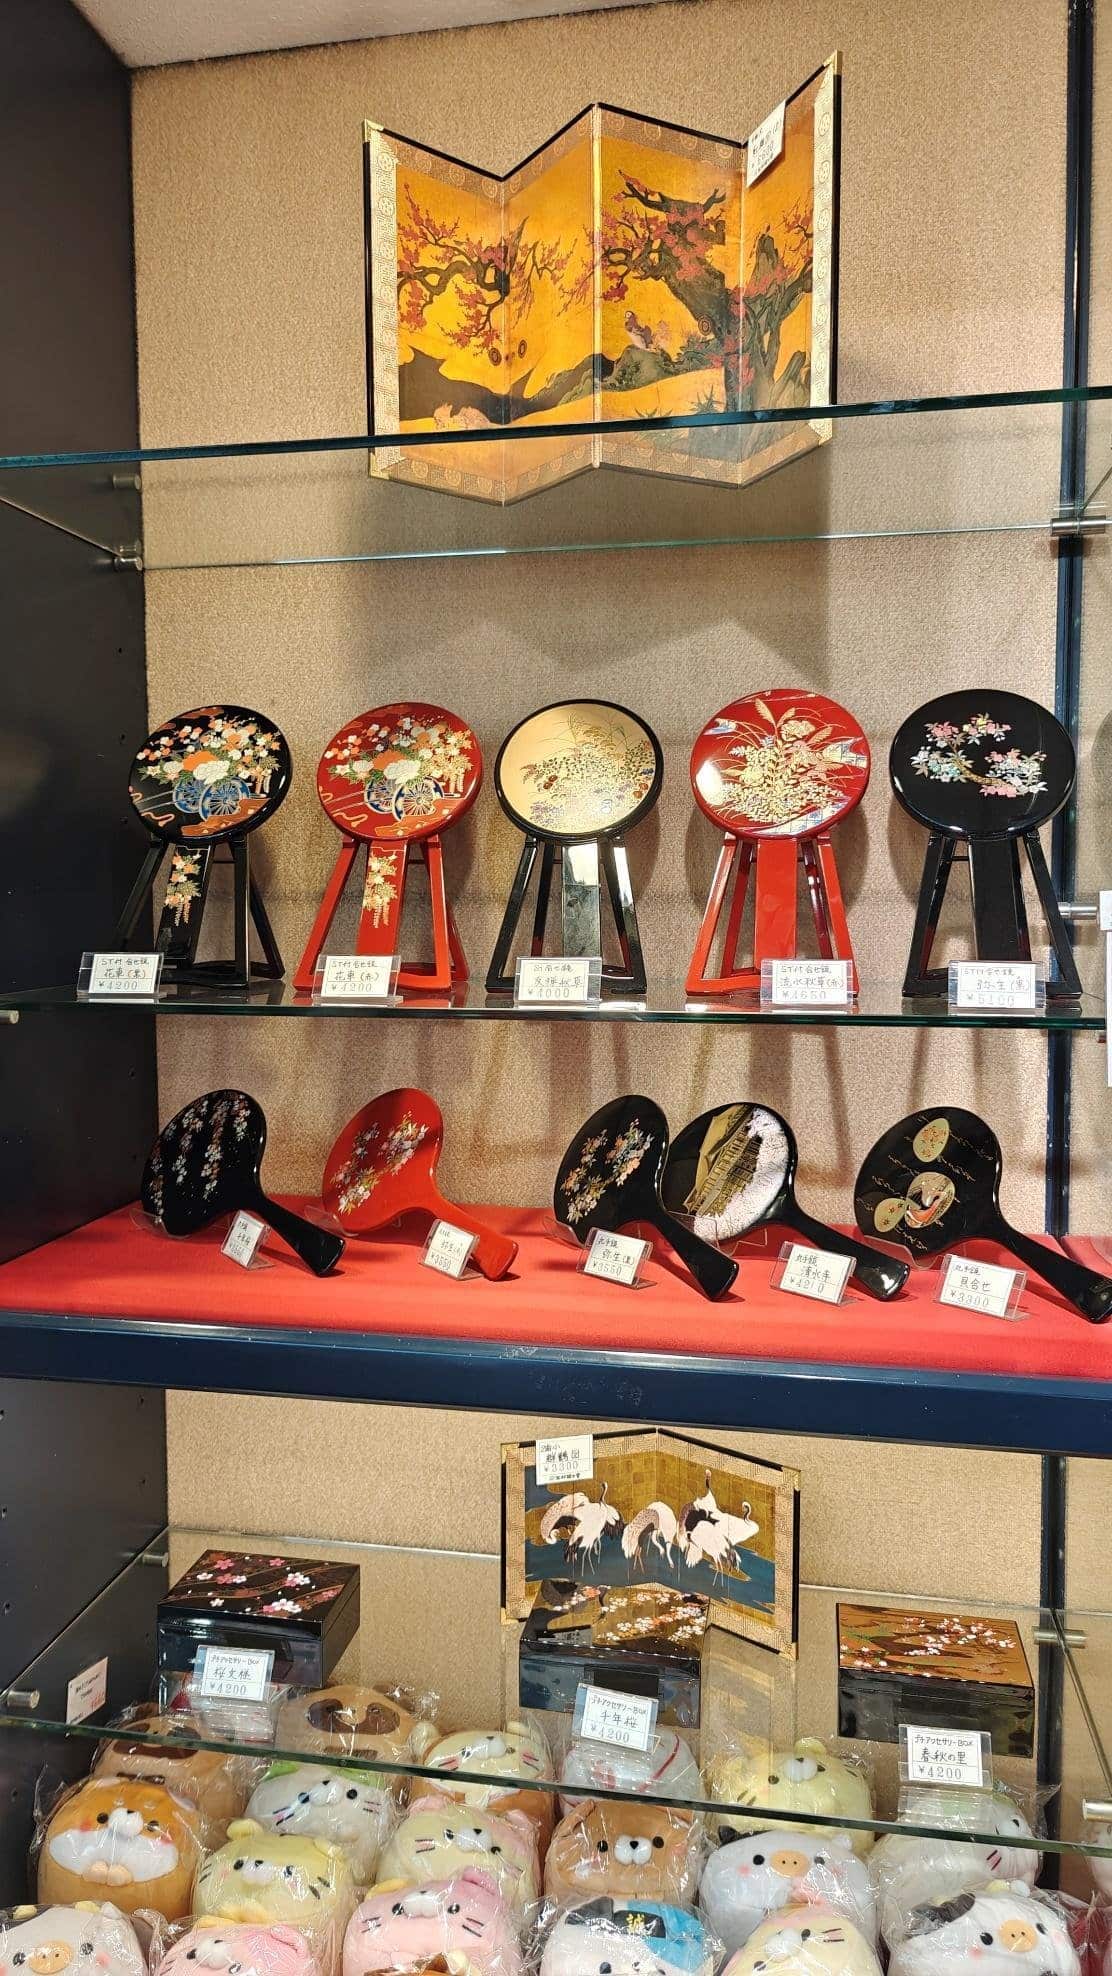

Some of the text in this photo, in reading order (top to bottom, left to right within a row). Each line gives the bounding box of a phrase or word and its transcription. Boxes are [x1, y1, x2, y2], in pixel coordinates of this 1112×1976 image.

[210, 1682, 247, 1695] ¥4200
[600, 1710, 638, 1728] 千年桜
[591, 1724, 630, 1743] ¥4200
[921, 1747, 967, 1765] 春秋の里
[919, 1765, 962, 1780] ¥4200
